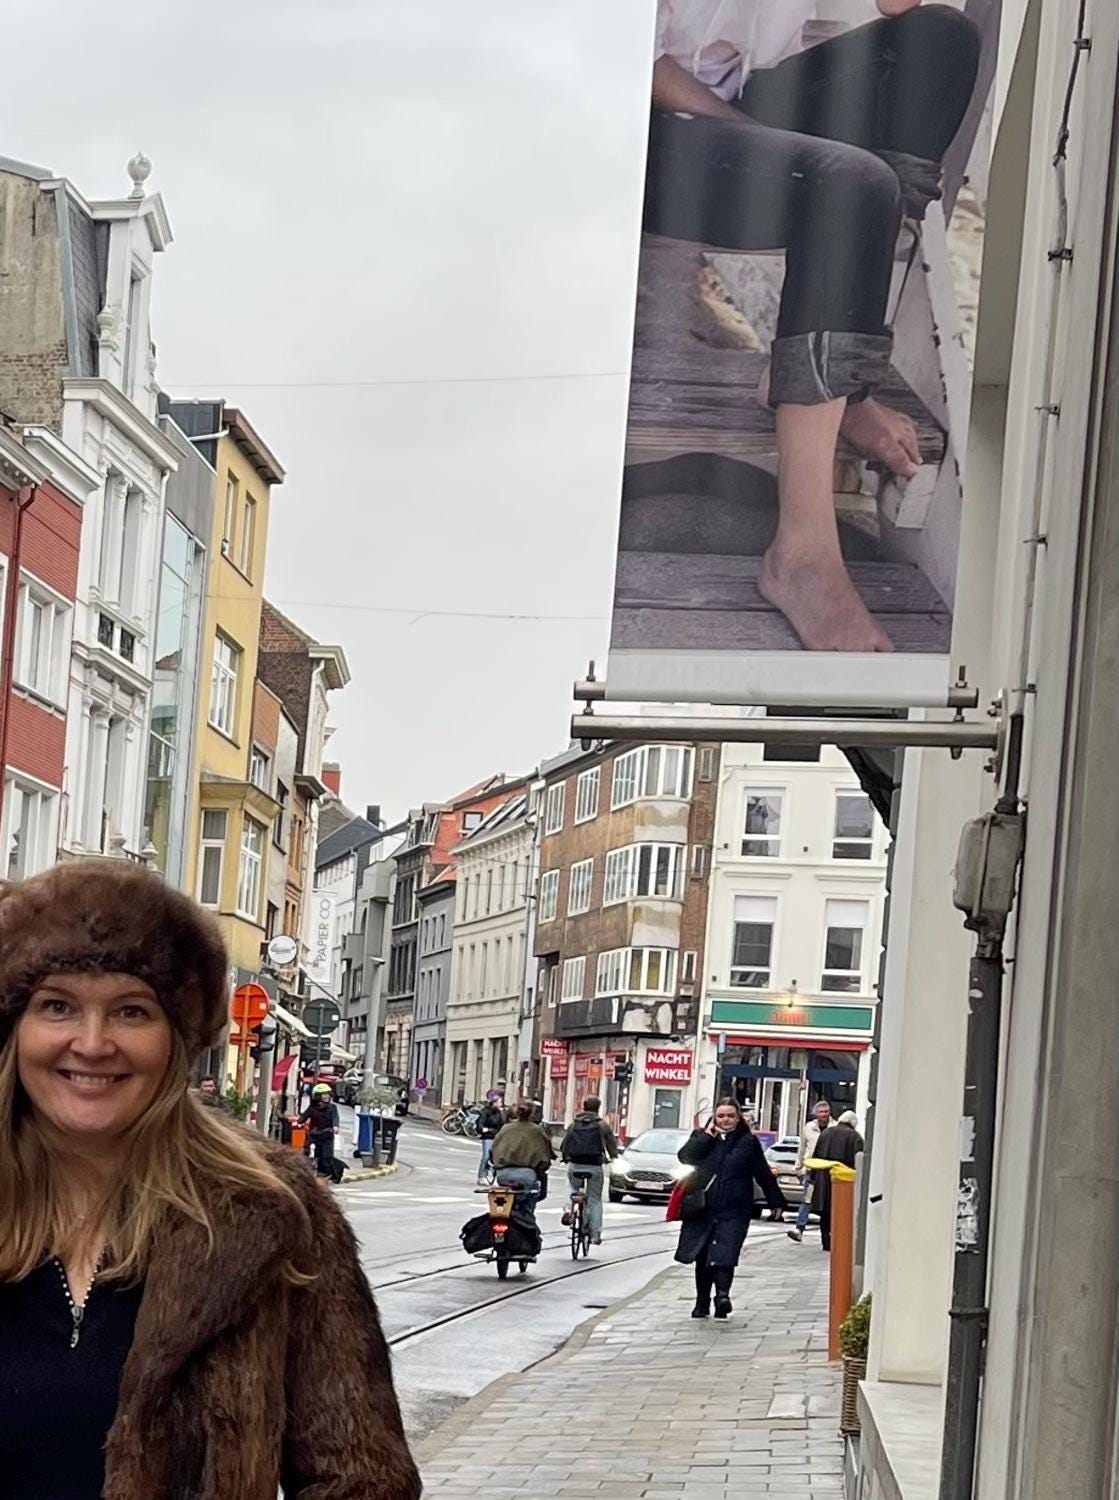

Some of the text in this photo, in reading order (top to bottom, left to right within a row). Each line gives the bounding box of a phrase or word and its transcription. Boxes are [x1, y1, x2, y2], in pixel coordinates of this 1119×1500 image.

[315, 898, 331, 961] PAPIER CO
[647, 1051, 691, 1065] NACHT
[645, 1068, 691, 1081] WINKEL
